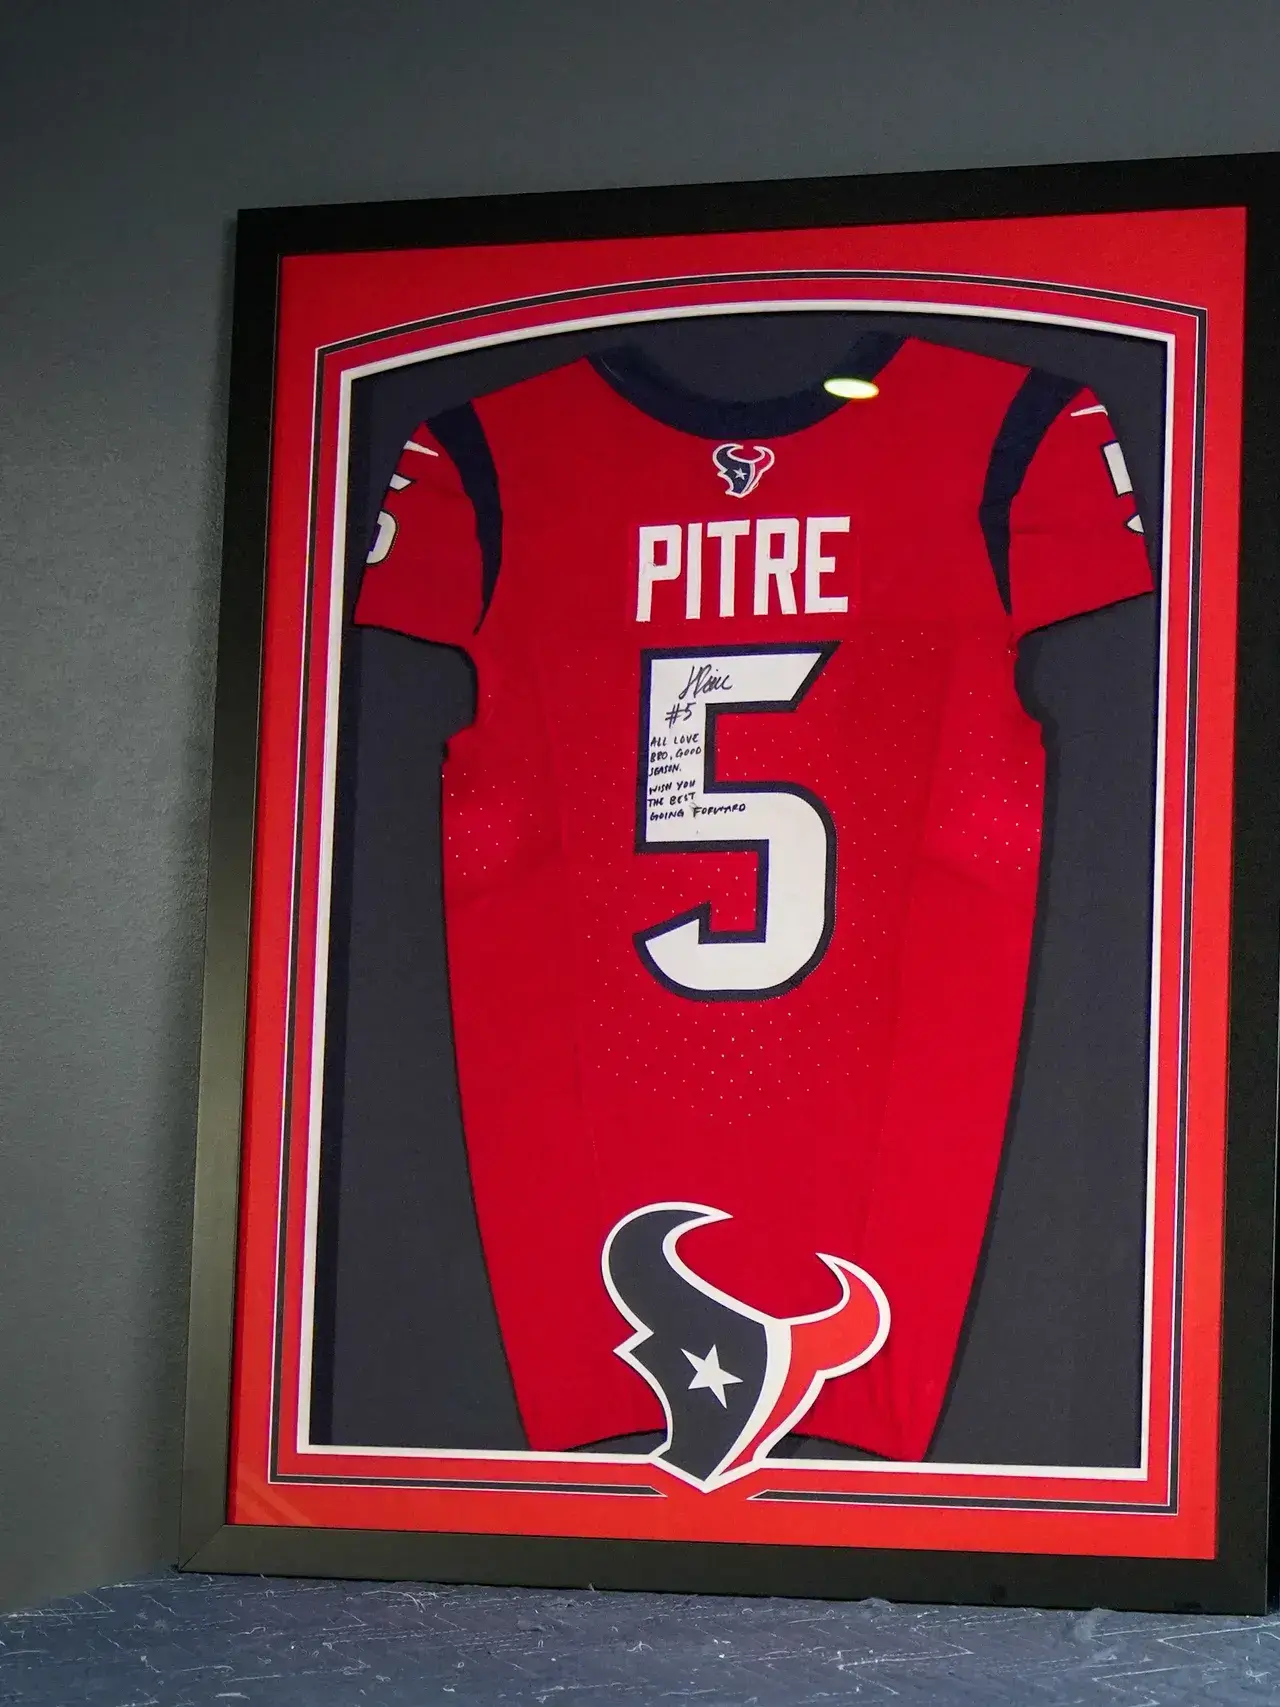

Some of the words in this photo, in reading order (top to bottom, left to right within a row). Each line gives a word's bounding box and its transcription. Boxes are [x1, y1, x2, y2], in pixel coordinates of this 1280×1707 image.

[635, 515, 852, 623] PITRE
[664, 702, 697, 729] #5
[650, 736, 667, 747] ALL
[673, 733, 700, 745] LOVE
[650, 750, 673, 763] BRO,
[675, 746, 702, 759] GOOD
[648, 763, 682, 777] SEASON.
[649, 781, 673, 795] WISH
[676, 779, 696, 791] YOU
[647, 797, 664, 808] THE
[669, 791, 696, 806] BEST
[649, 808, 685, 822] GOING
[692, 802, 746, 819] FORWARD
[632, 640, 844, 1002] 5
